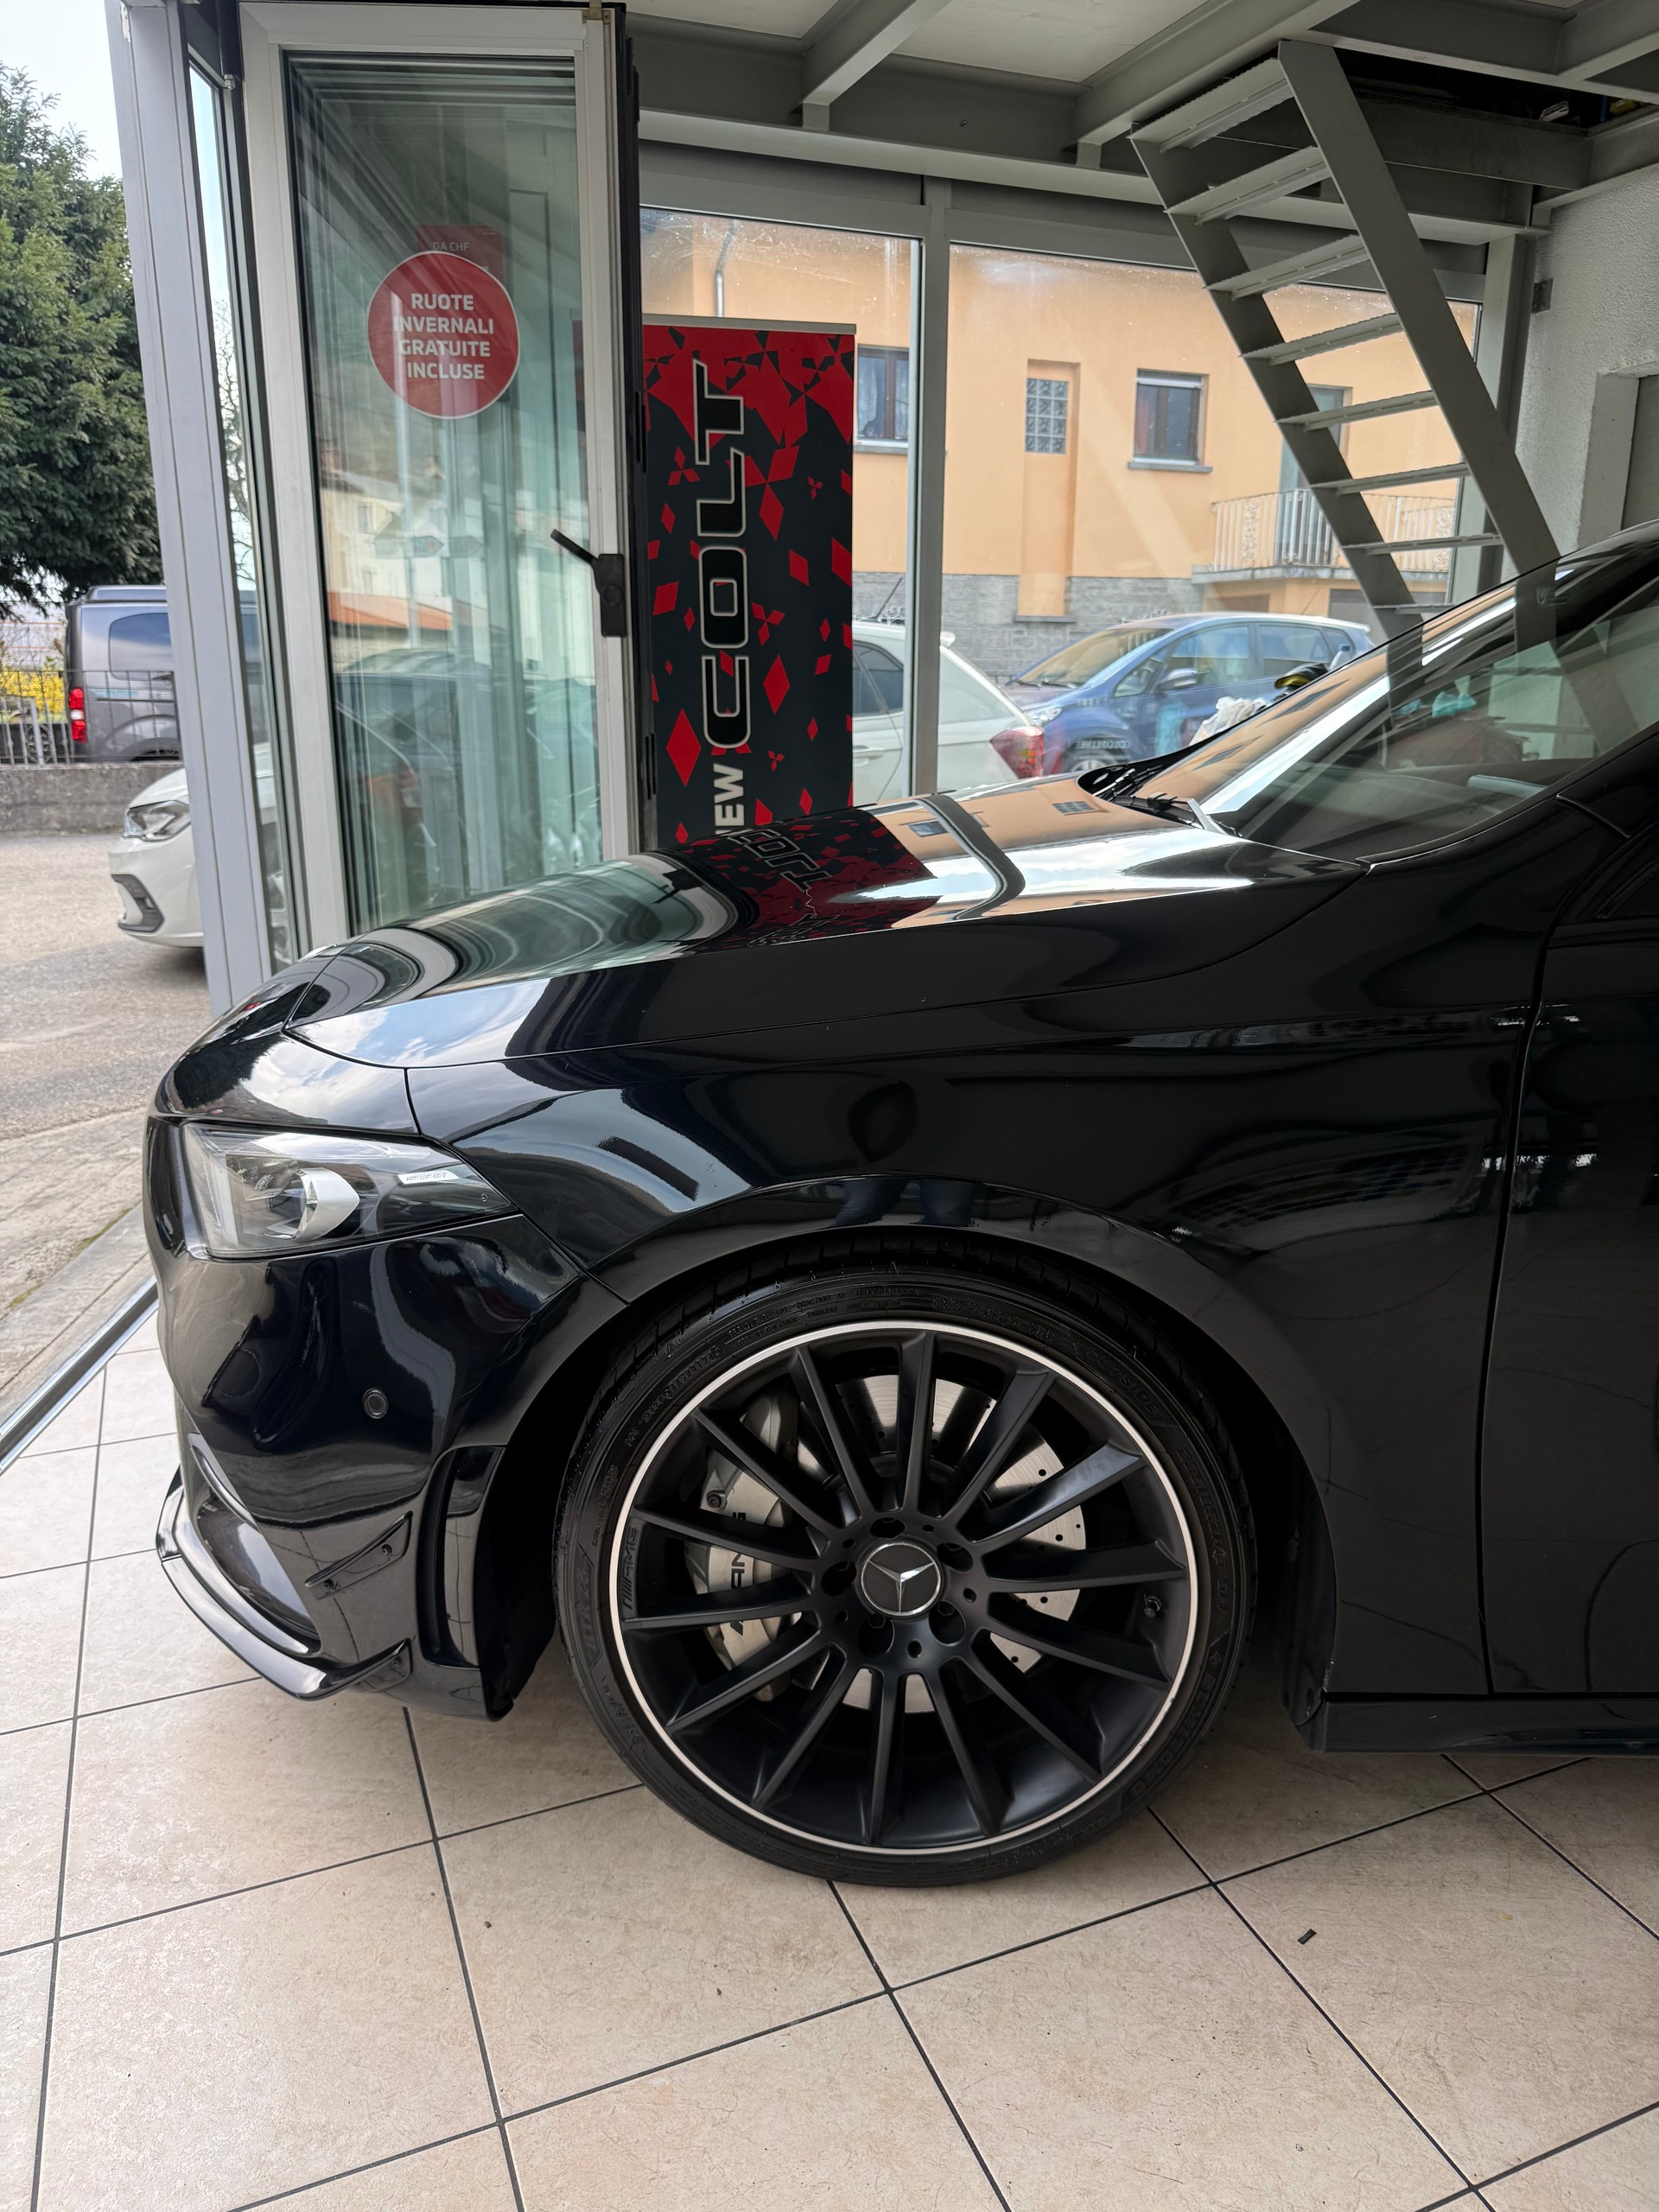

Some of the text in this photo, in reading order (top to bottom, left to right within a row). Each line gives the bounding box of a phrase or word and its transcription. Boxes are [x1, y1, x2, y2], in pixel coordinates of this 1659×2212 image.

[433, 242, 469, 251] DA CHF
[411, 294, 474, 310] RUOTE
[394, 316, 493, 334] INVERNALI
[398, 340, 491, 357] GRATUITE
[407, 362, 485, 379] INCLUSE
[692, 358, 751, 836] EW COLT
[622, 1526, 639, 1583] AMG
